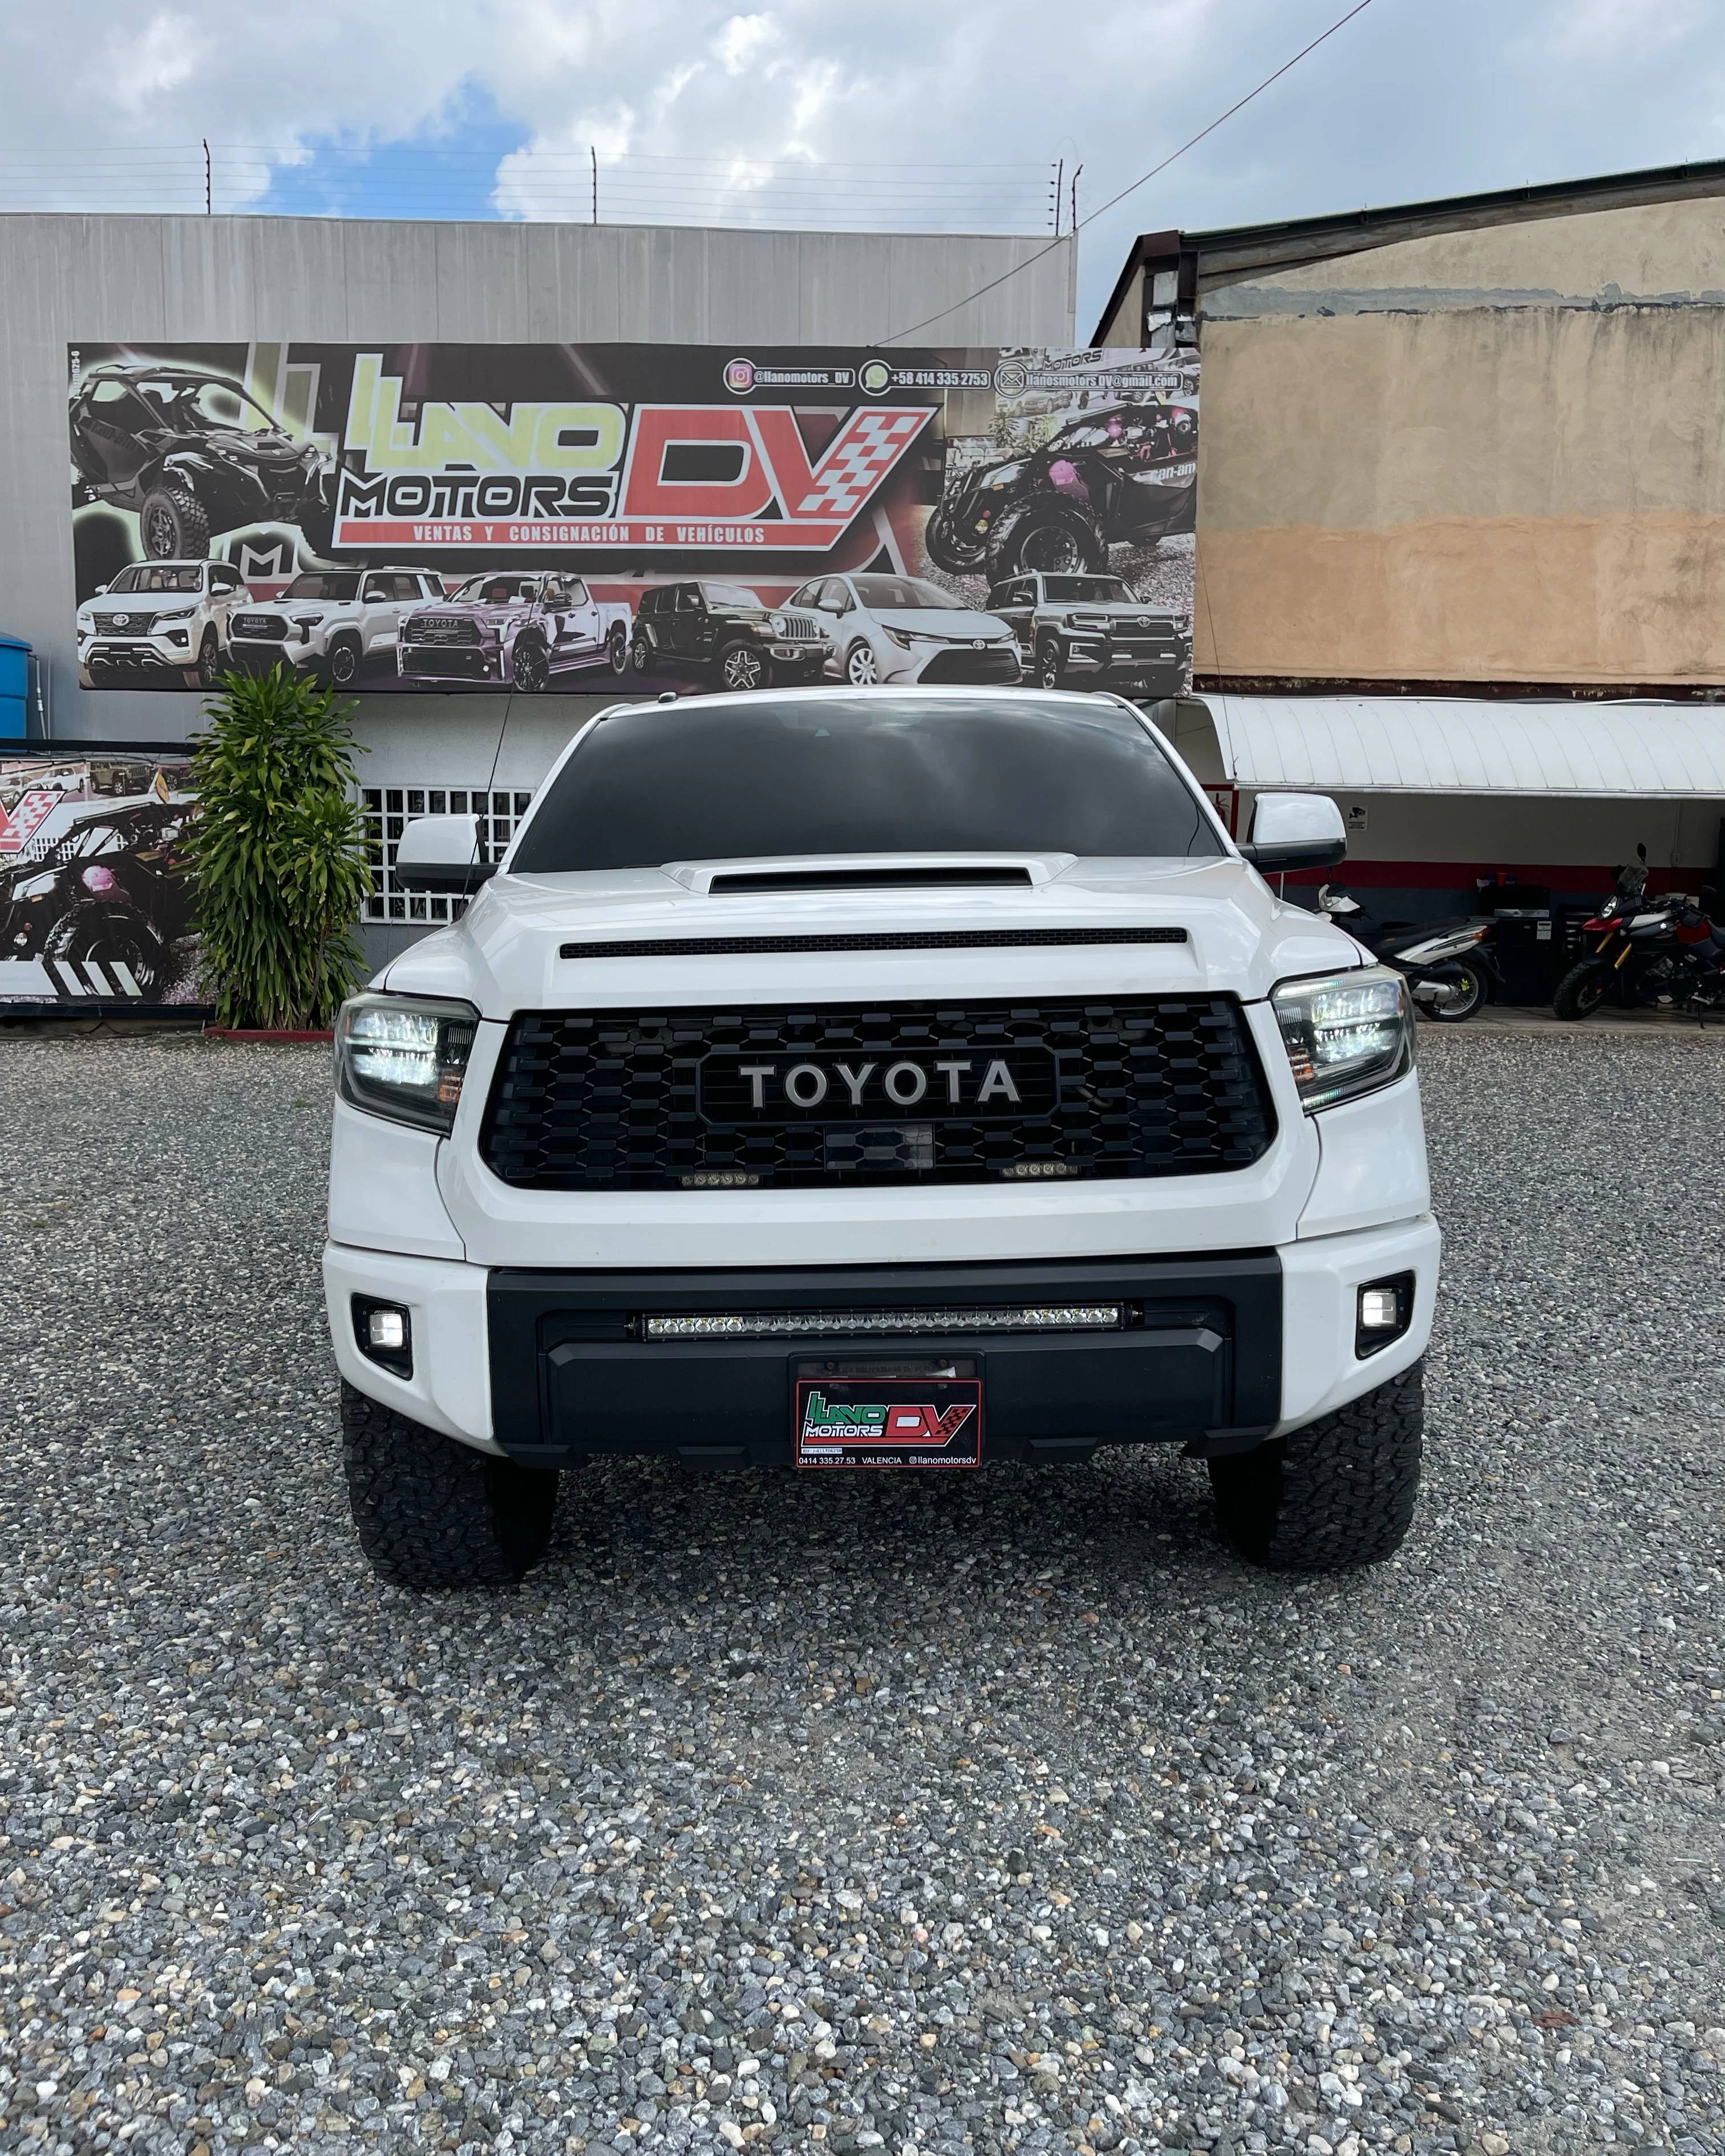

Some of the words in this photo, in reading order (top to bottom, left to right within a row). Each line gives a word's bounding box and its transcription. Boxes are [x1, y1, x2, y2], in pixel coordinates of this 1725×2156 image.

[754, 371, 849, 385] @llanomotors_DV
[891, 372, 914, 384] +58
[916, 372, 934, 384] 414
[622, 407, 934, 520] DV
[341, 475, 623, 518] MOTORS
[413, 525, 472, 541] VENTAS
[484, 526, 493, 541] Y
[509, 523, 629, 542] CONSIGNACIÓN
[645, 526, 664, 542] DE
[677, 524, 764, 543] VEHÍCULOS
[423, 619, 458, 628] TOYOTA
[739, 1059, 1022, 1110] TOYOTA
[805, 1425, 884, 1437] MOTORS
[885, 1405, 975, 1437] DV
